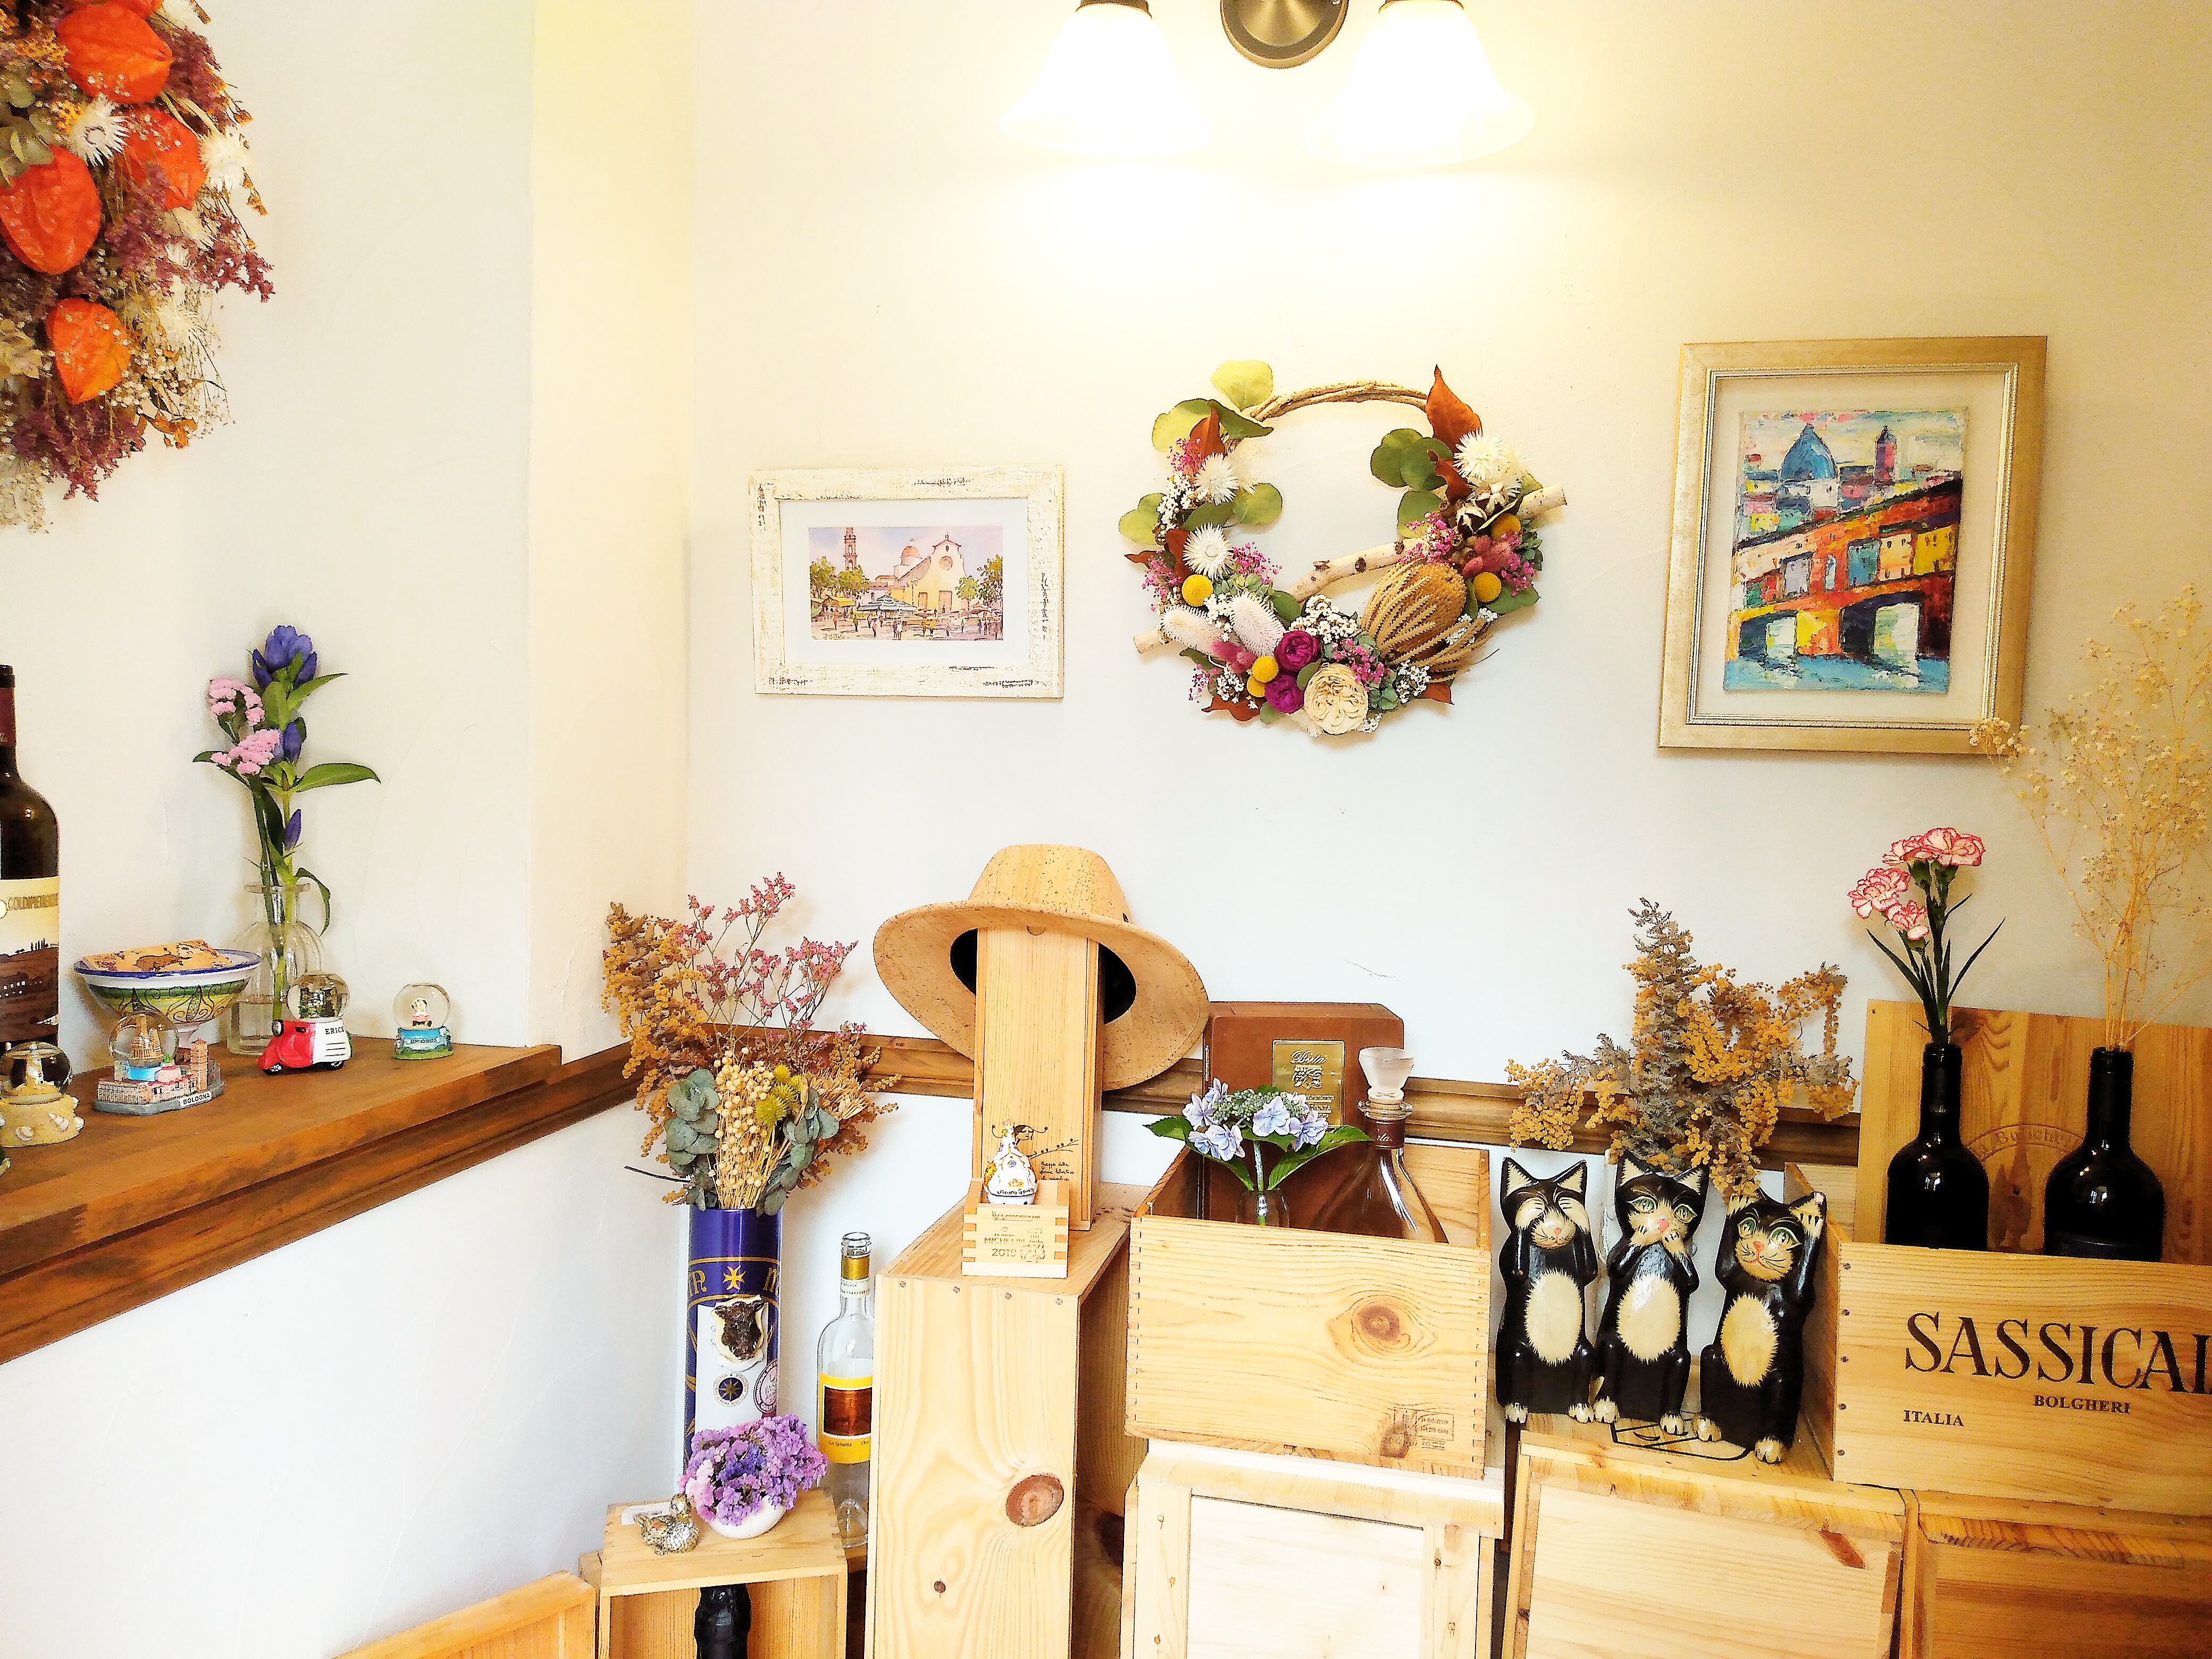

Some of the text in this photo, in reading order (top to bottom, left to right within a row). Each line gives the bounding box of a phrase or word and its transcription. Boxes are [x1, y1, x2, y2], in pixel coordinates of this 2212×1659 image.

[183, 1093, 210, 1105] BOLOGNA
[2033, 1394, 2131, 1414] BOLGHERI
[1904, 1410, 1965, 1427] ITALIA
